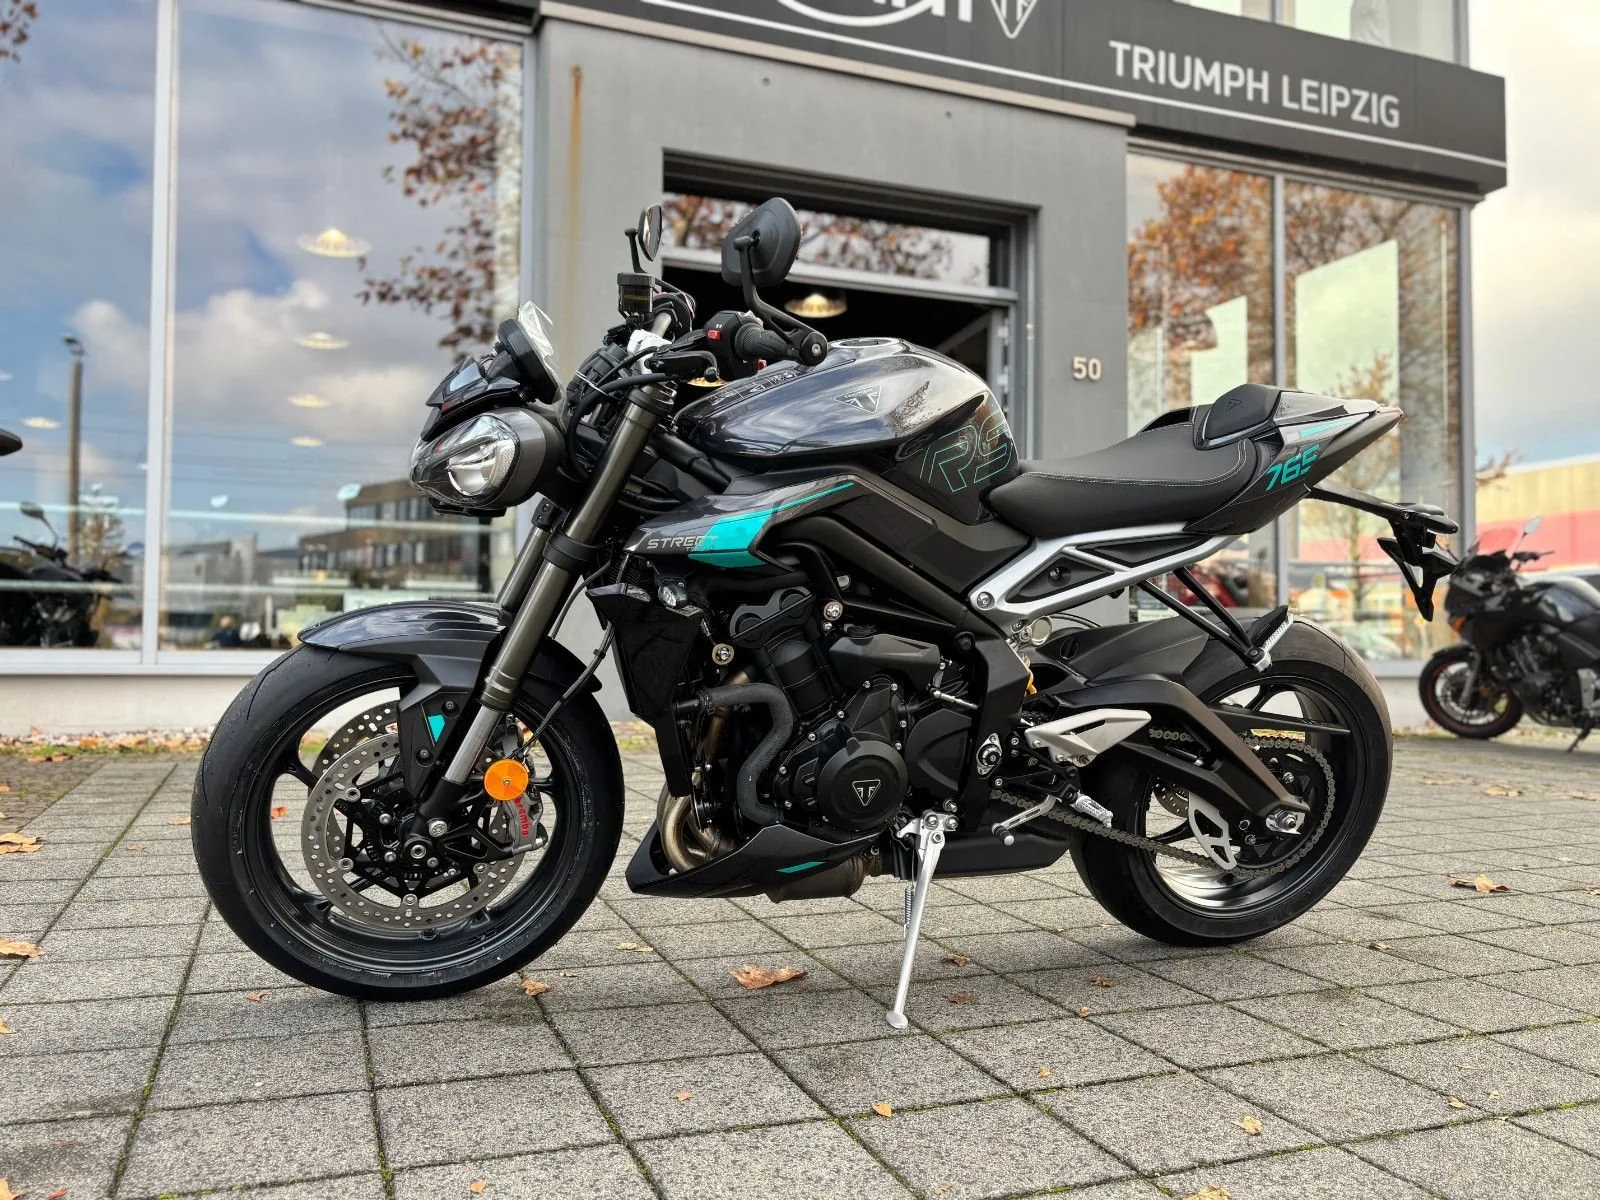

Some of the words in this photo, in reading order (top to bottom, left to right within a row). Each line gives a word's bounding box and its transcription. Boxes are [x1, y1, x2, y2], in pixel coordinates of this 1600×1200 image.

[1109, 40, 1269, 104] TRIUMPH
[1281, 75, 1400, 128] LEIPZIG
[1073, 356, 1101, 380] 50
[919, 408, 1013, 493] RS
[1265, 444, 1320, 492] 765
